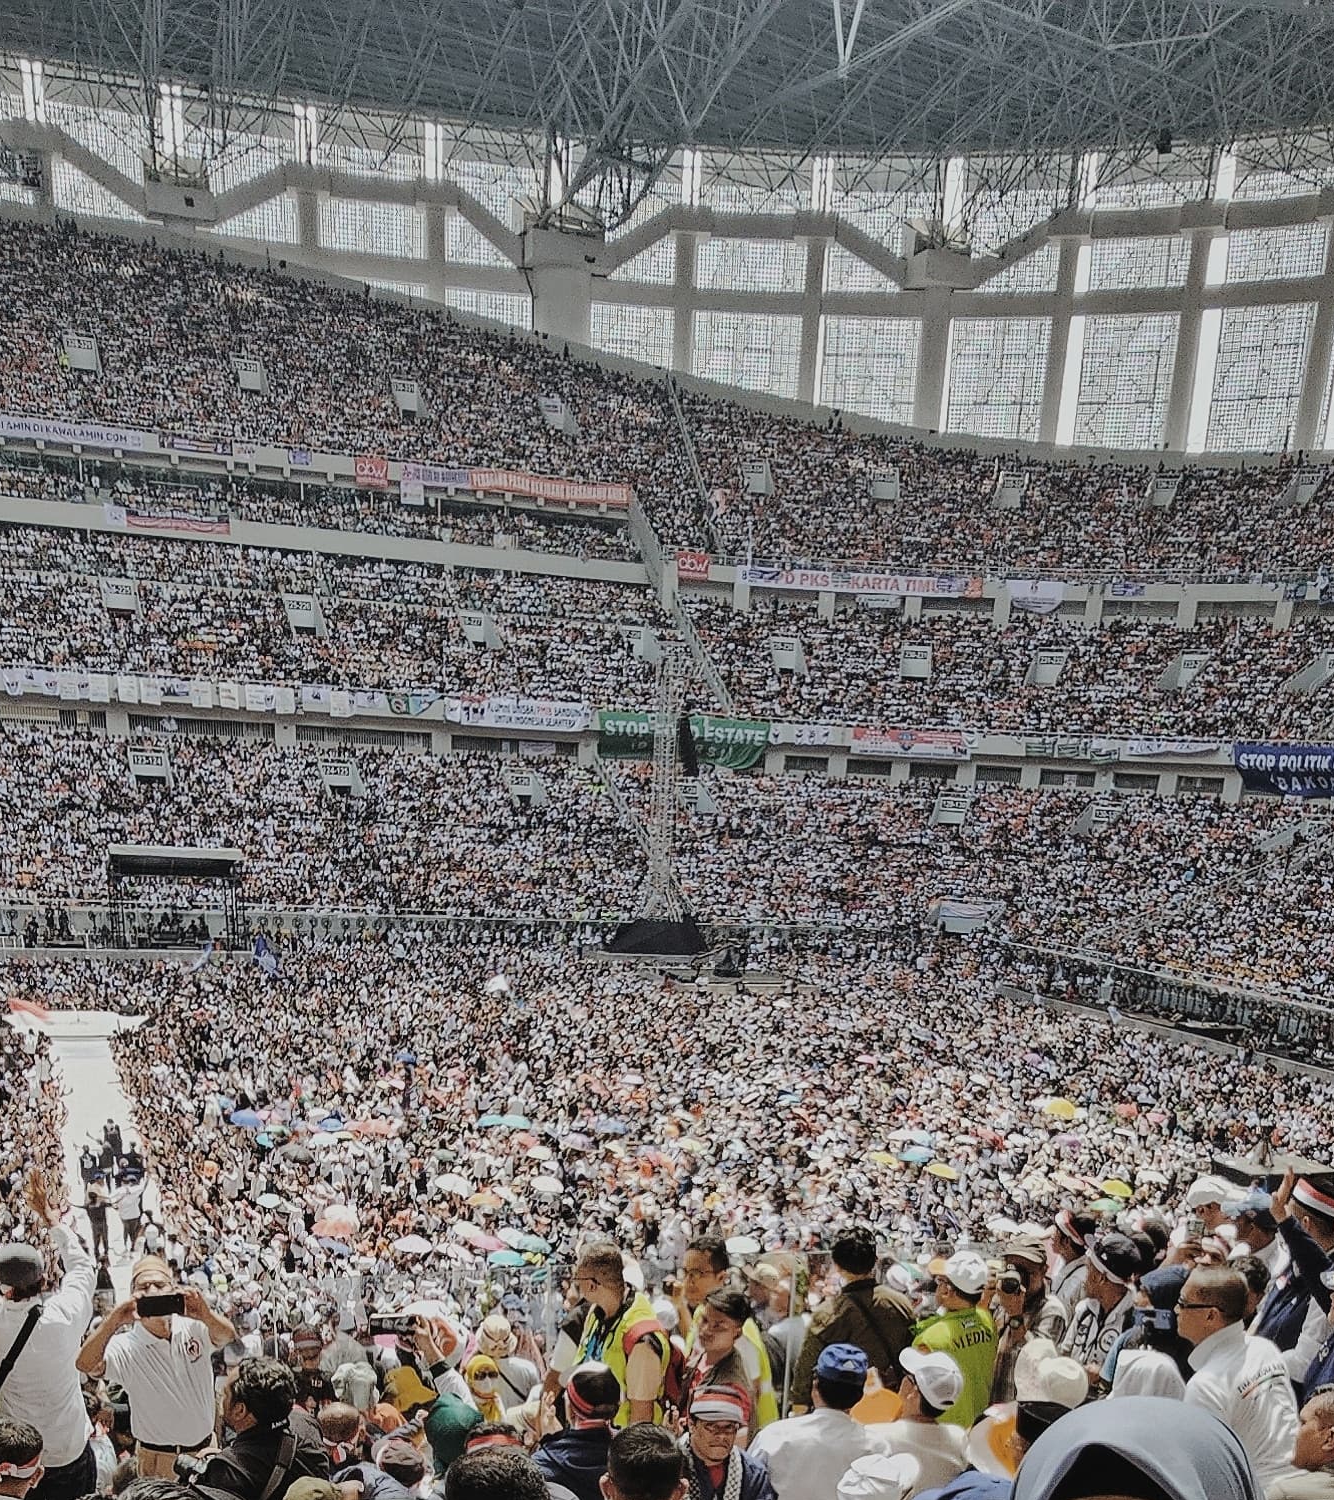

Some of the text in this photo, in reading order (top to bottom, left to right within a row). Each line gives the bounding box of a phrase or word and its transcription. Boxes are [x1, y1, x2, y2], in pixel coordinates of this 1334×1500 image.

[7, 421, 31, 432] AMIN
[800, 574, 830, 587] PKS
[604, 720, 651, 737] STOP
[704, 727, 767, 746] ESTATE
[1239, 753, 1276, 771] STOP
[1279, 755, 1332, 772] POLITIK
[953, 1329, 992, 1350] MEDIS
